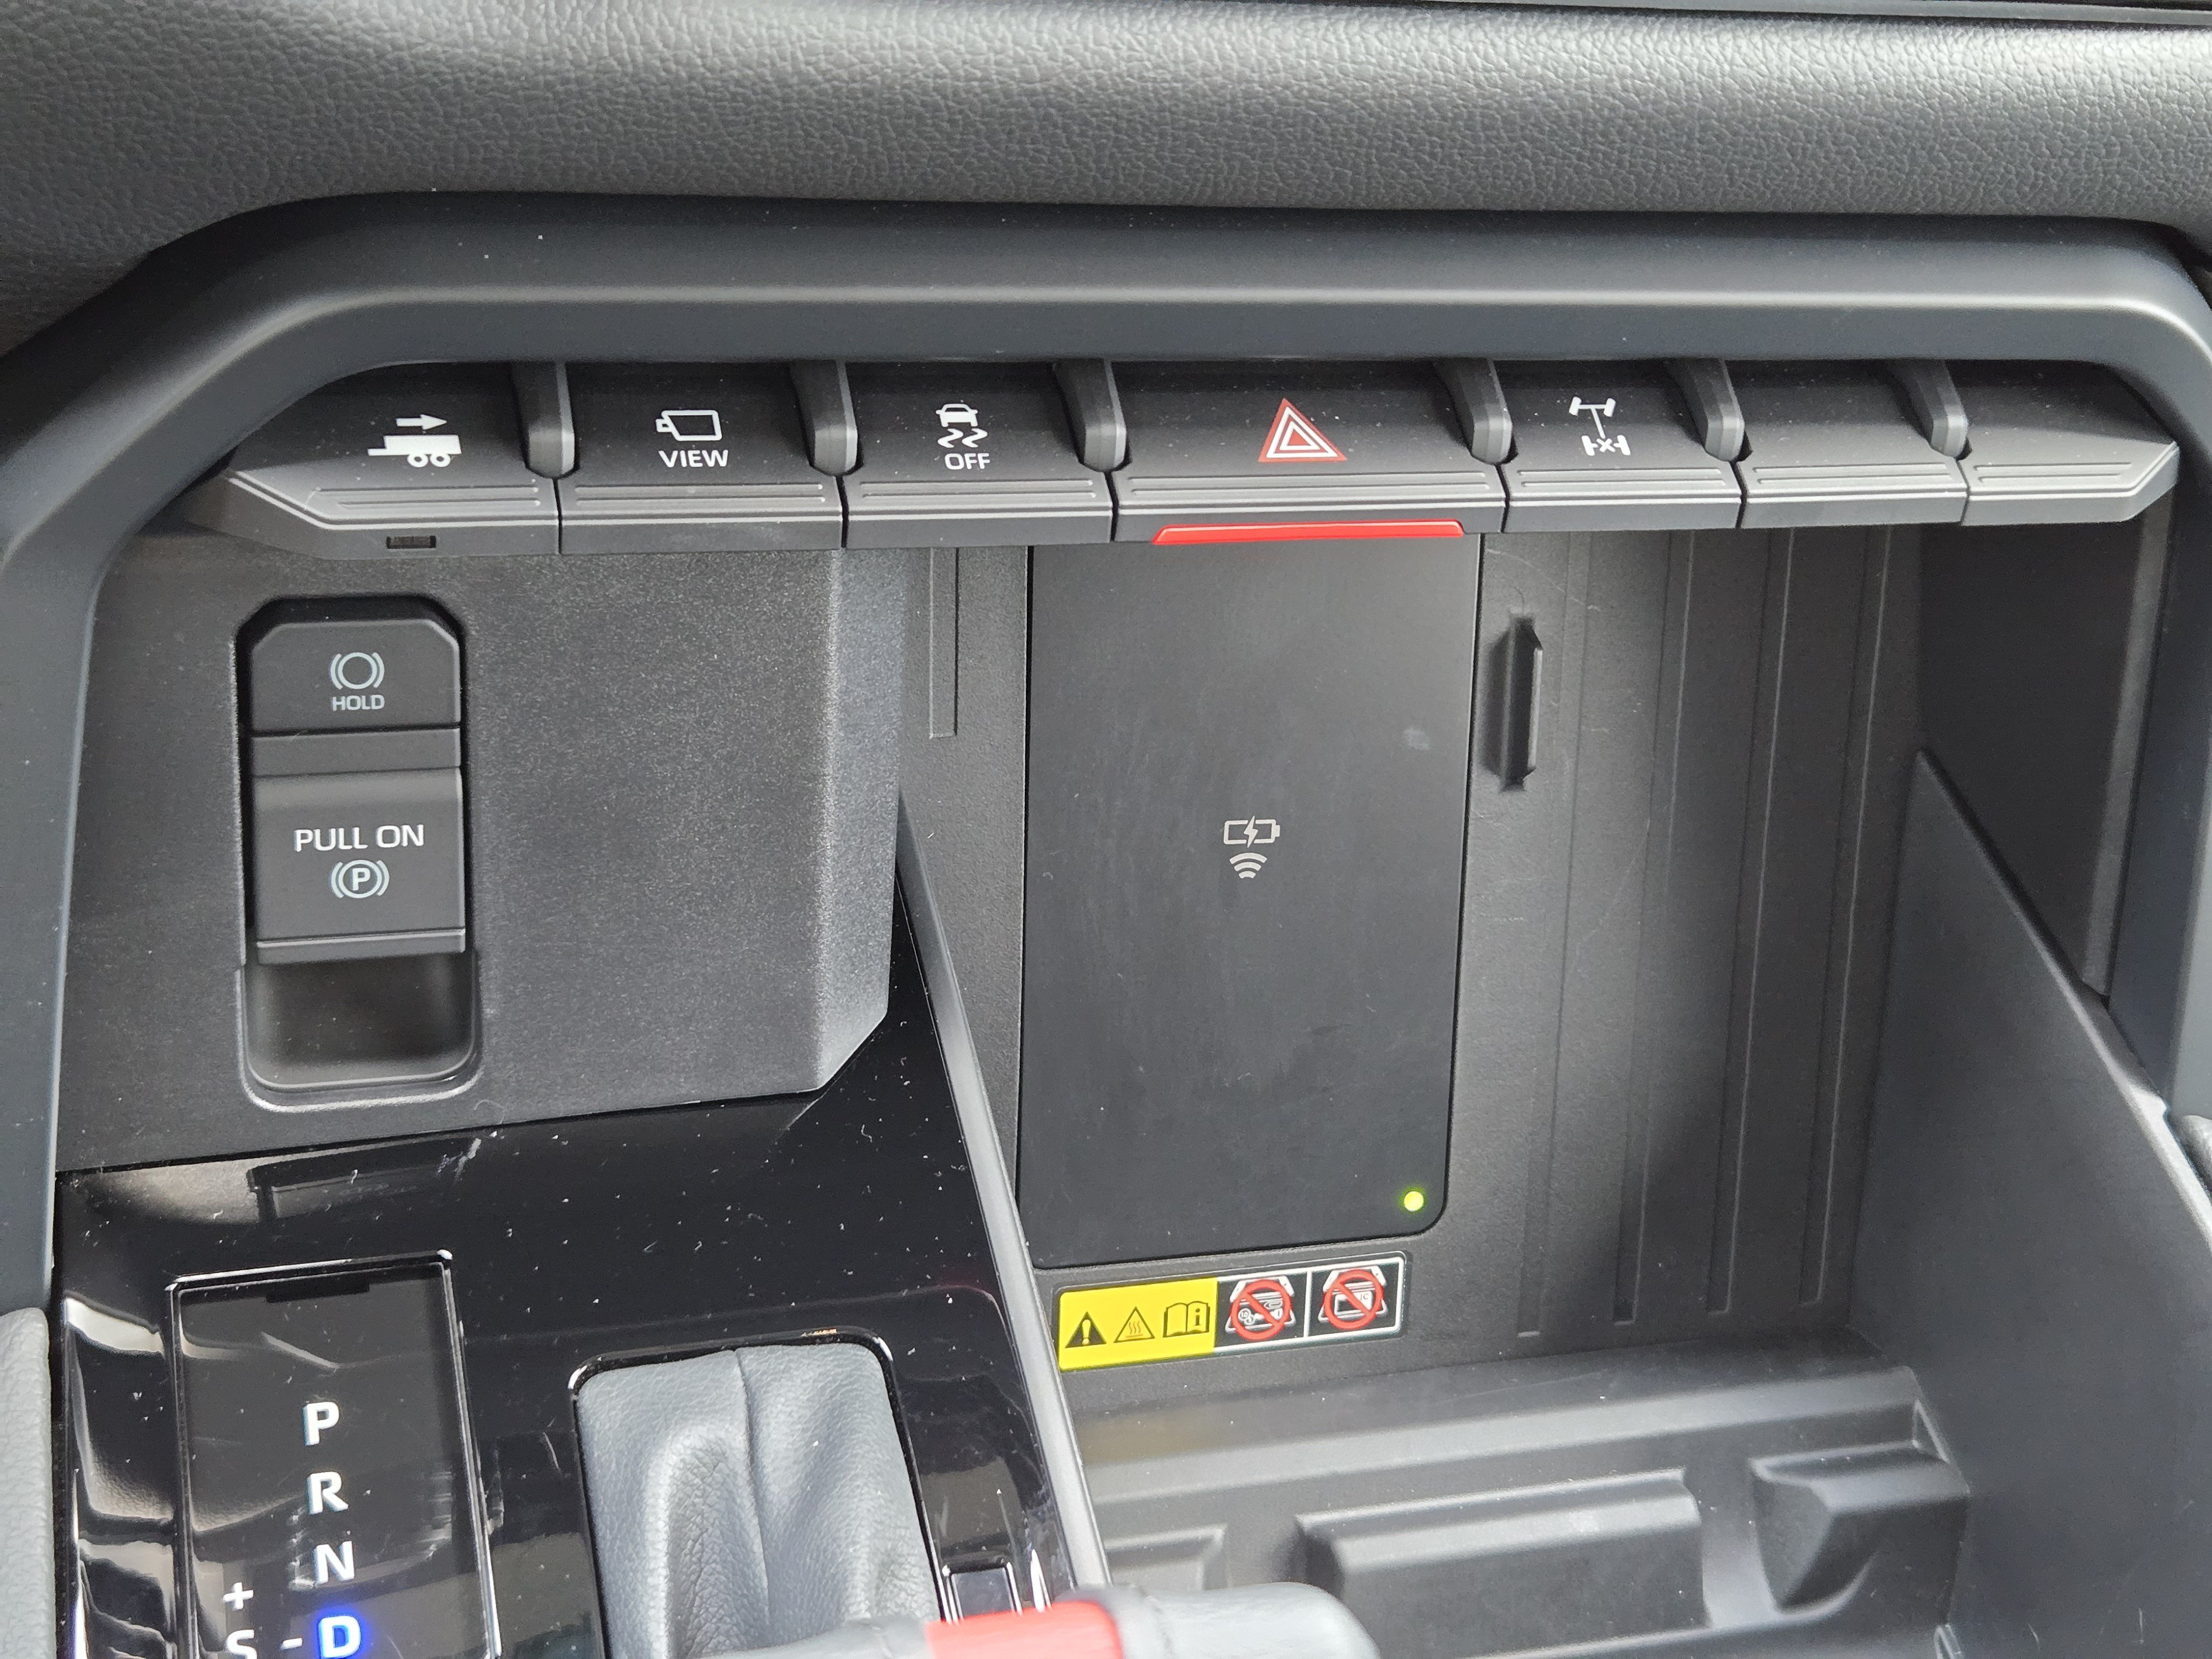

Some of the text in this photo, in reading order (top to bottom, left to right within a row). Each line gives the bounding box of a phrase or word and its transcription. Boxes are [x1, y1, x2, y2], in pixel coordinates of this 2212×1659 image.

[659, 449, 728, 468] VIEW
[945, 453, 990, 470] OFF
[332, 694, 385, 711] HOLD
[294, 824, 425, 852] PULL ON
[351, 867, 371, 891] P
[302, 1401, 340, 1446] P
[306, 1471, 349, 1514] R
[313, 1541, 356, 1584] N
[226, 1629, 258, 1659] S
[319, 1615, 361, 1658] D
